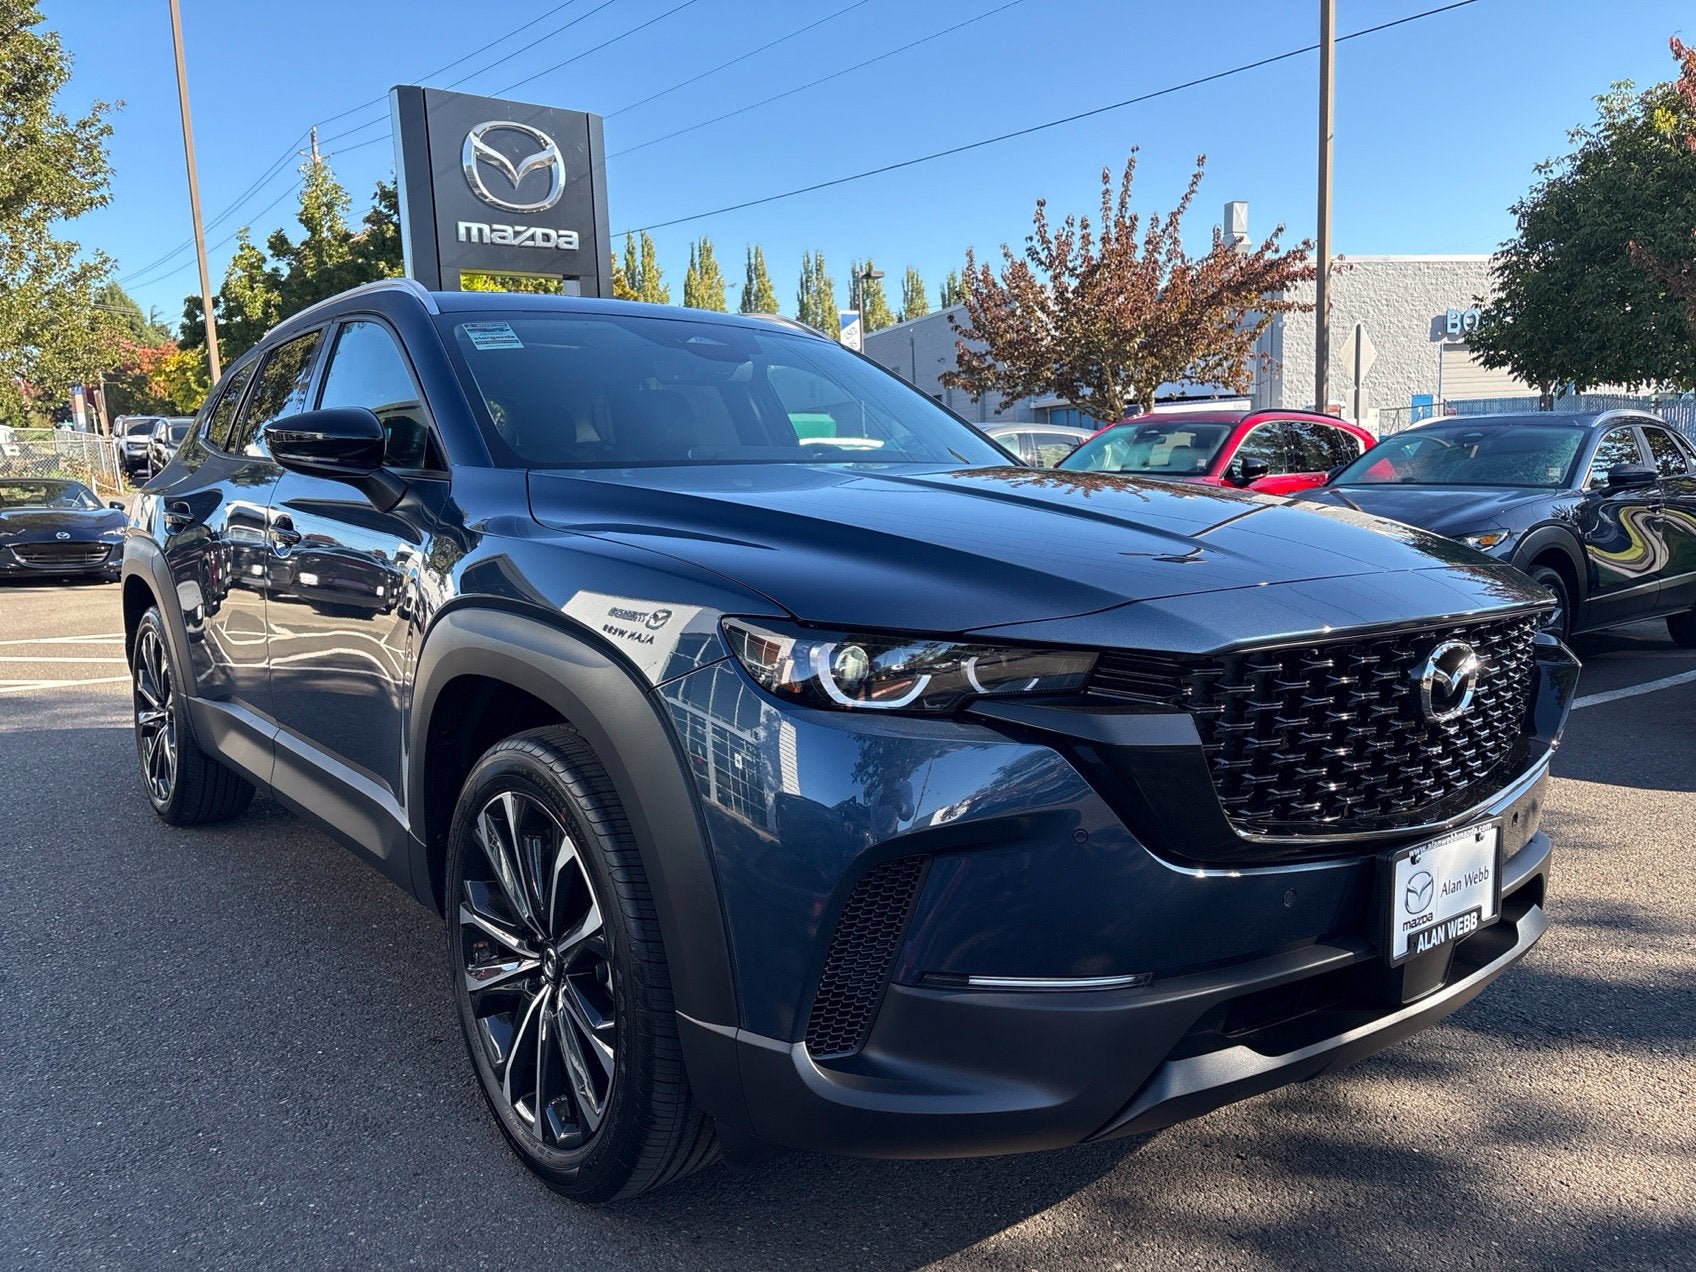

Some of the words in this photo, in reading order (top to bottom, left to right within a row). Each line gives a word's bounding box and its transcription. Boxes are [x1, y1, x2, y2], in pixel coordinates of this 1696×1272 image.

[1440, 880, 1462, 898] Alan
[1464, 867, 1490, 888] Webb
[1416, 924, 1446, 953] ALAN
[1447, 911, 1478, 939] WEBB
